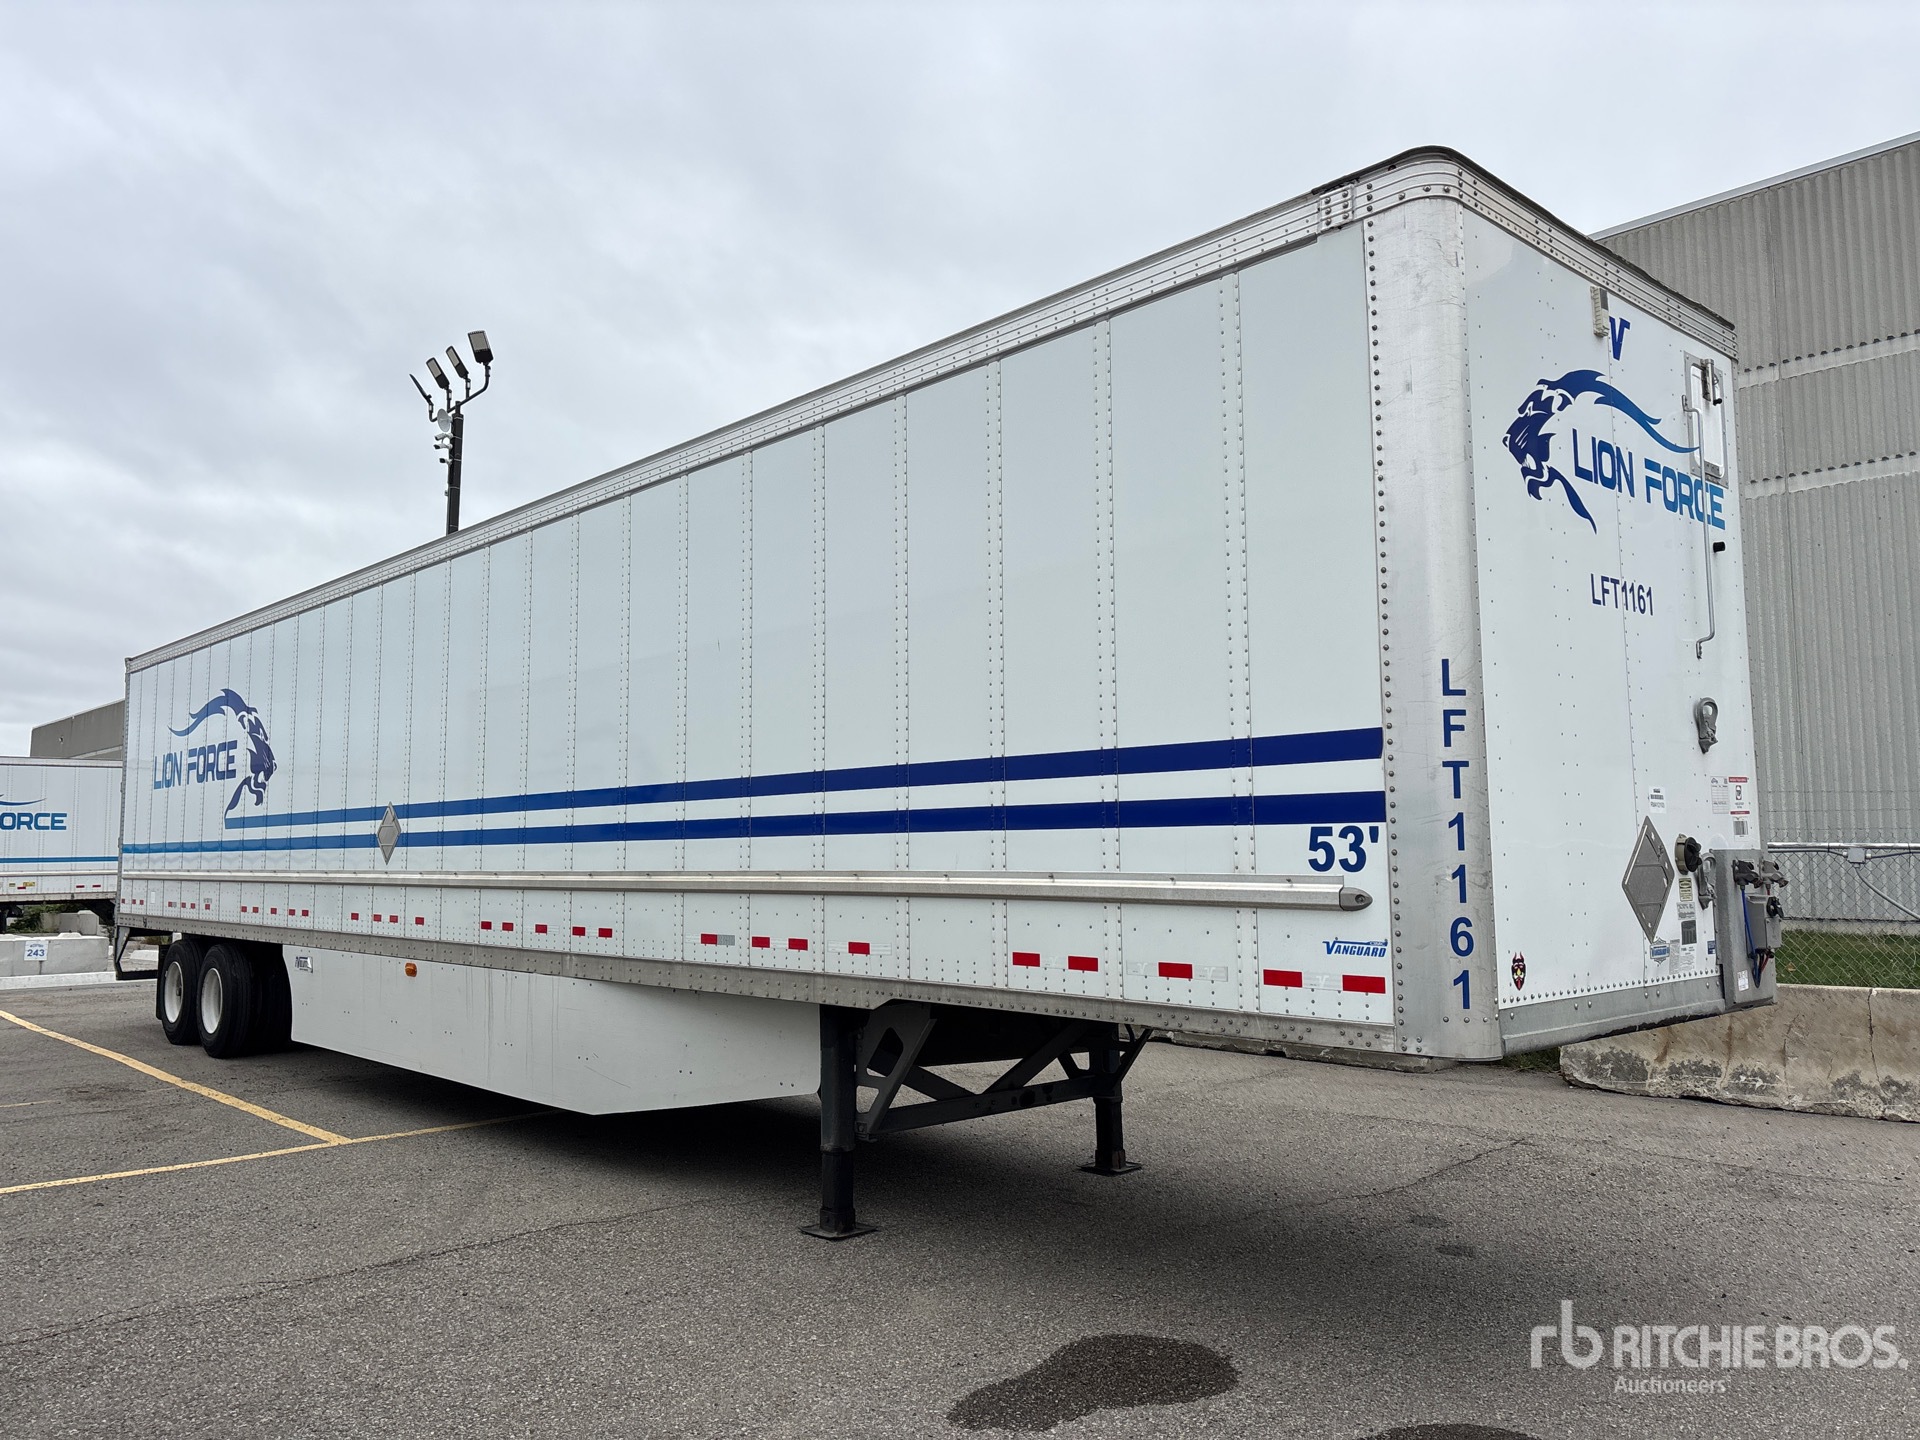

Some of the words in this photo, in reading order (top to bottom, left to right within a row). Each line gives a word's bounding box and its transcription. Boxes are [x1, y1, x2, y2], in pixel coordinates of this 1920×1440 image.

[1572, 428, 1635, 498] LION
[1644, 457, 1726, 531] FORCE
[1590, 573, 1653, 616] LFT1161
[153, 750, 183, 790] LION
[186, 739, 238, 785] FORCE
[1307, 825, 1380, 873] 53'
[1441, 658, 1475, 1010] LFT1161
[27, 949, 45, 957] 243
